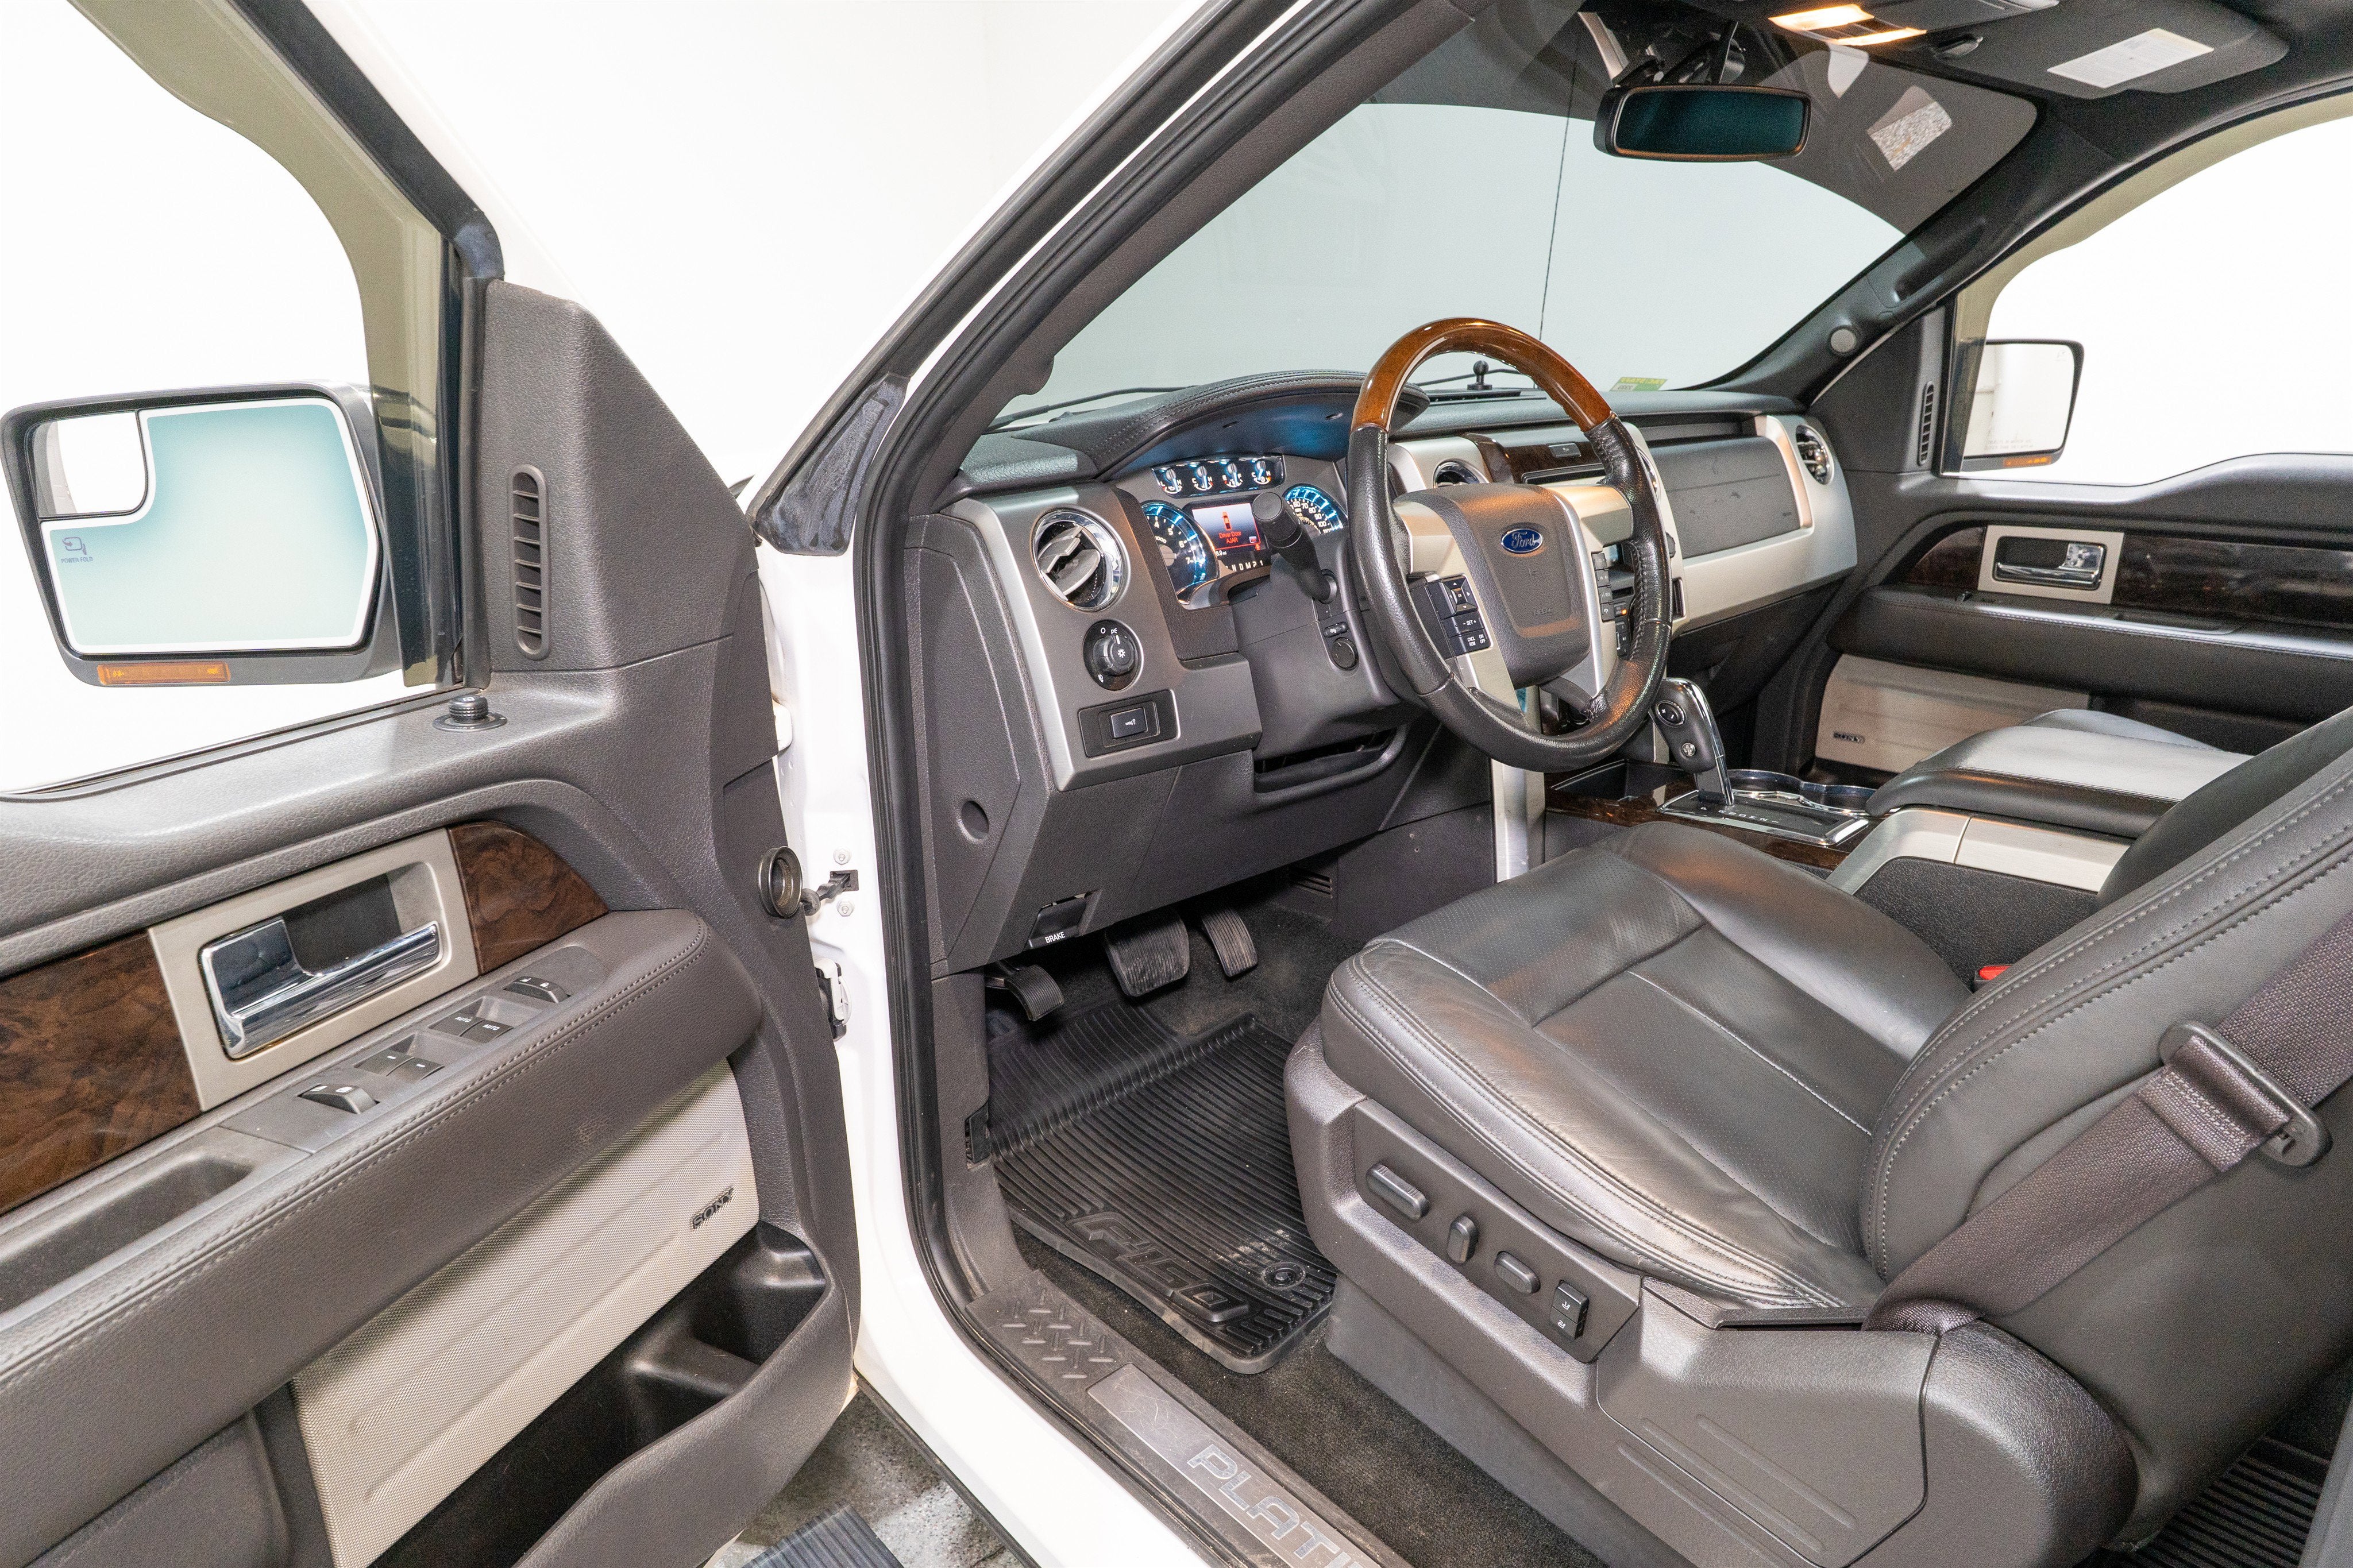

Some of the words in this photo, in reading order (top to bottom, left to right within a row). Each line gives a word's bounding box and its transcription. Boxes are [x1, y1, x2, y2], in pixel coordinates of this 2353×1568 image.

[1511, 531, 1536, 549] Ford
[1044, 931, 1066, 944] BRAKE
[693, 1187, 734, 1229] SONY
[1187, 1443, 1365, 1568] PLATI
